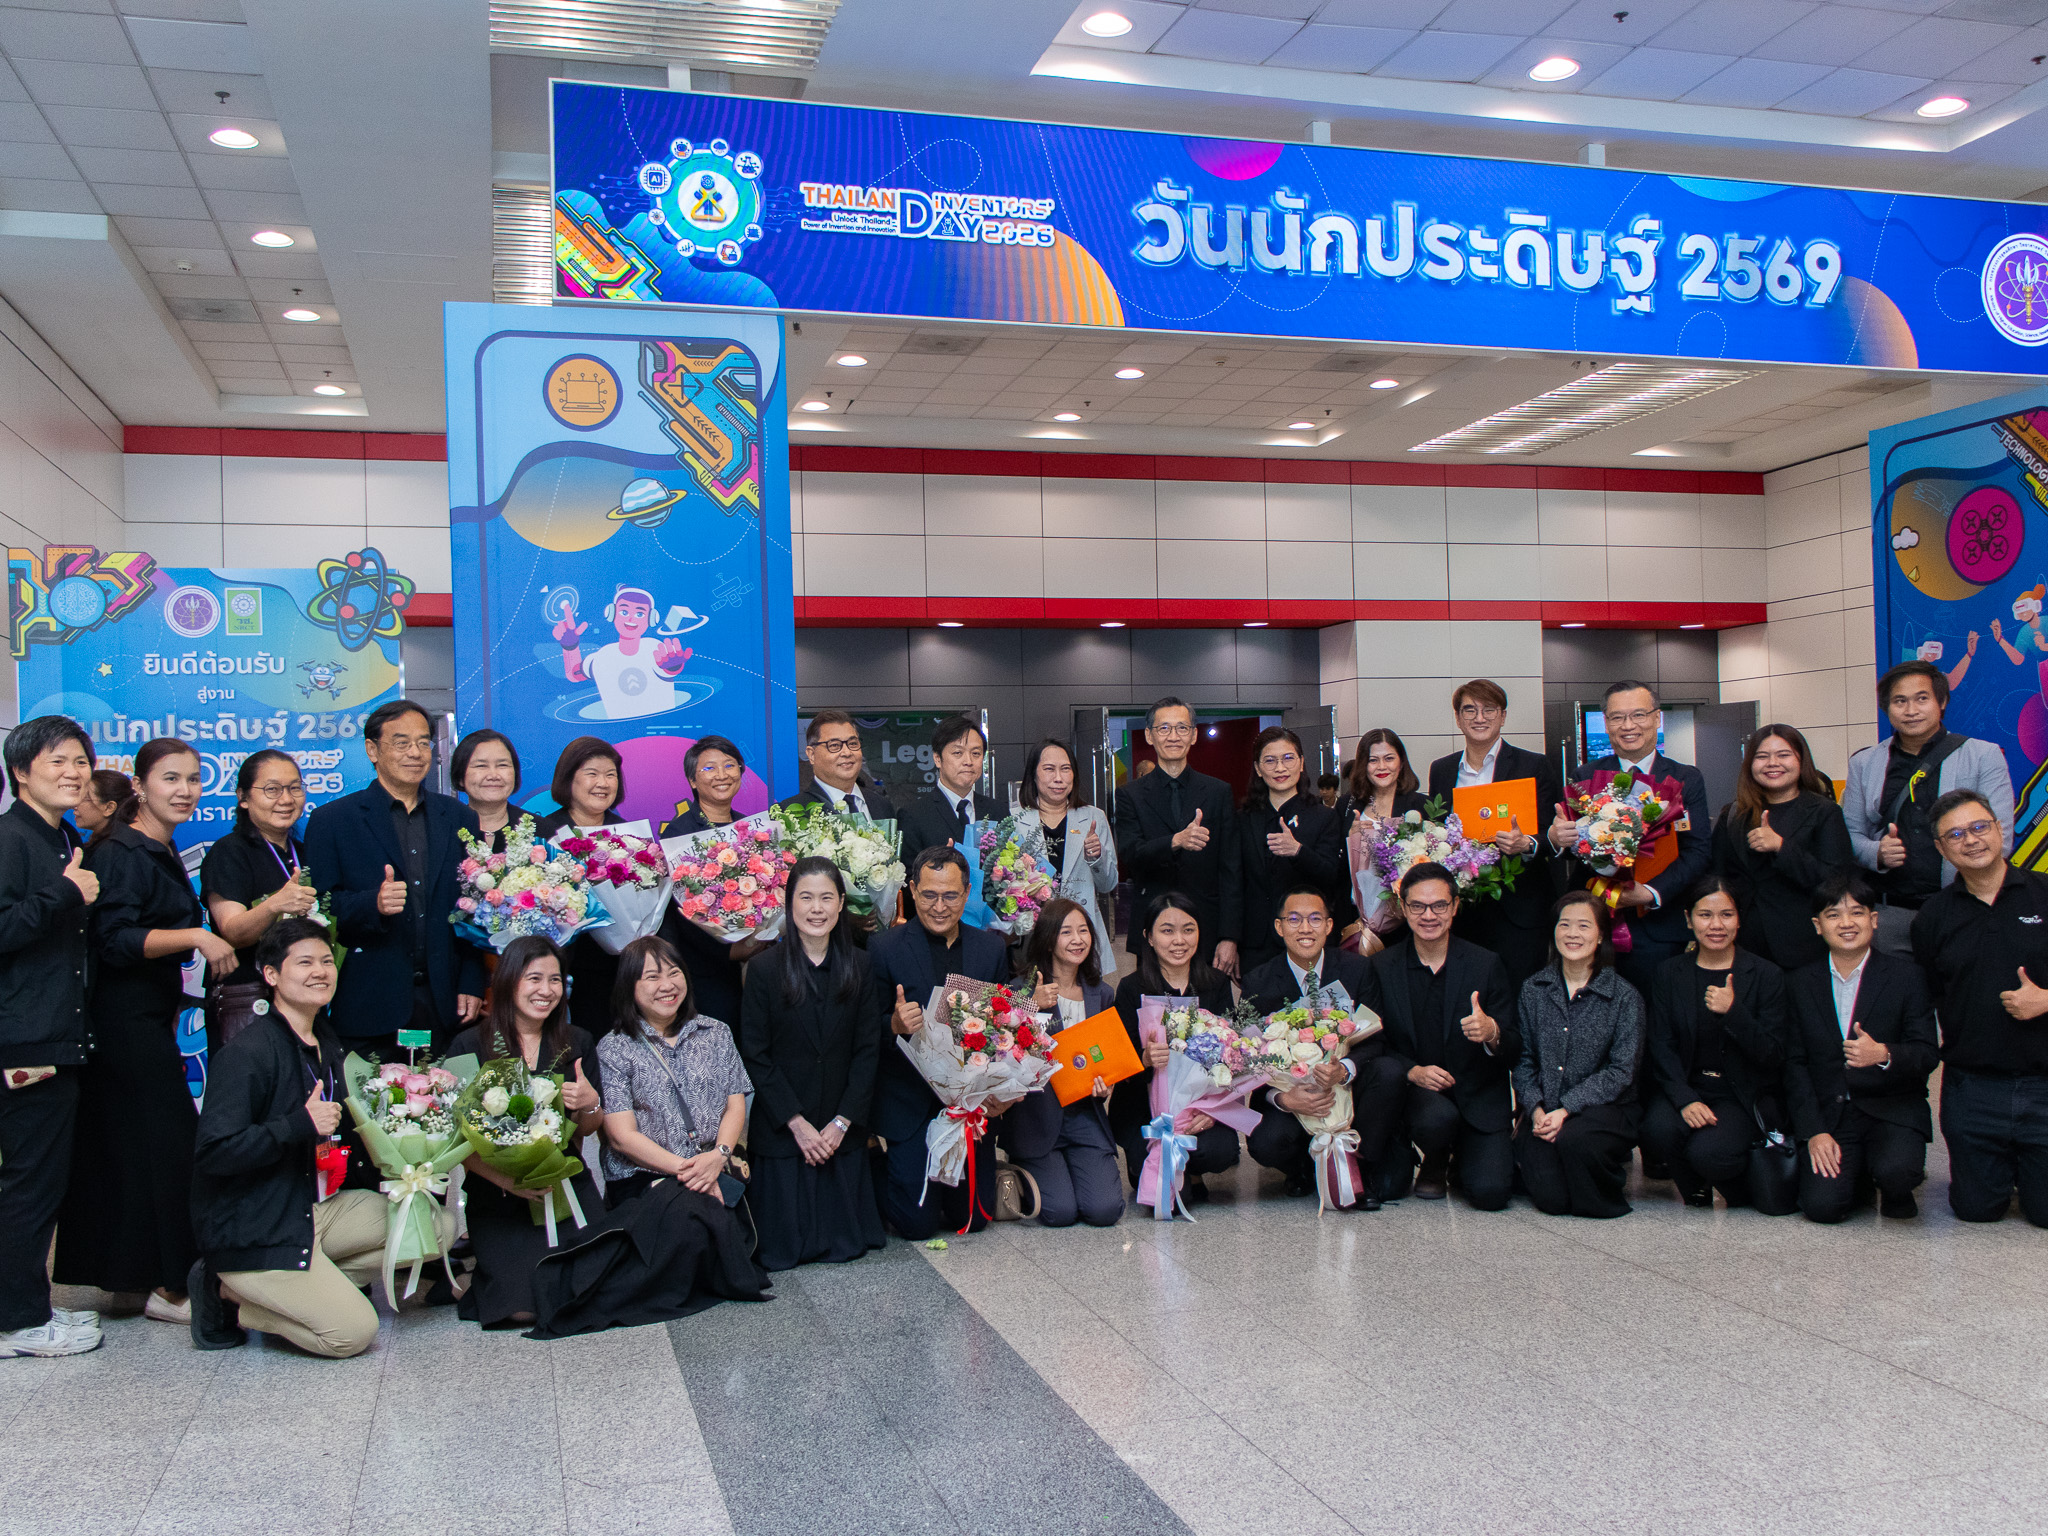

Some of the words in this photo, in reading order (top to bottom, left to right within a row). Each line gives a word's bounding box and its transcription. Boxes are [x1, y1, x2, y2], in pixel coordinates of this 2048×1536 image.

[651, 175, 661, 184] AI
[834, 213, 858, 223] Unlock
[860, 216, 891, 225] Thailand
[829, 223, 855, 231] Invention
[1136, 181, 1661, 313] วันนักประดิษฐ์
[1680, 233, 1842, 305] 2569
[144, 650, 285, 675] ยินดีต้อนรับ
[197, 685, 235, 704] สู่งาน
